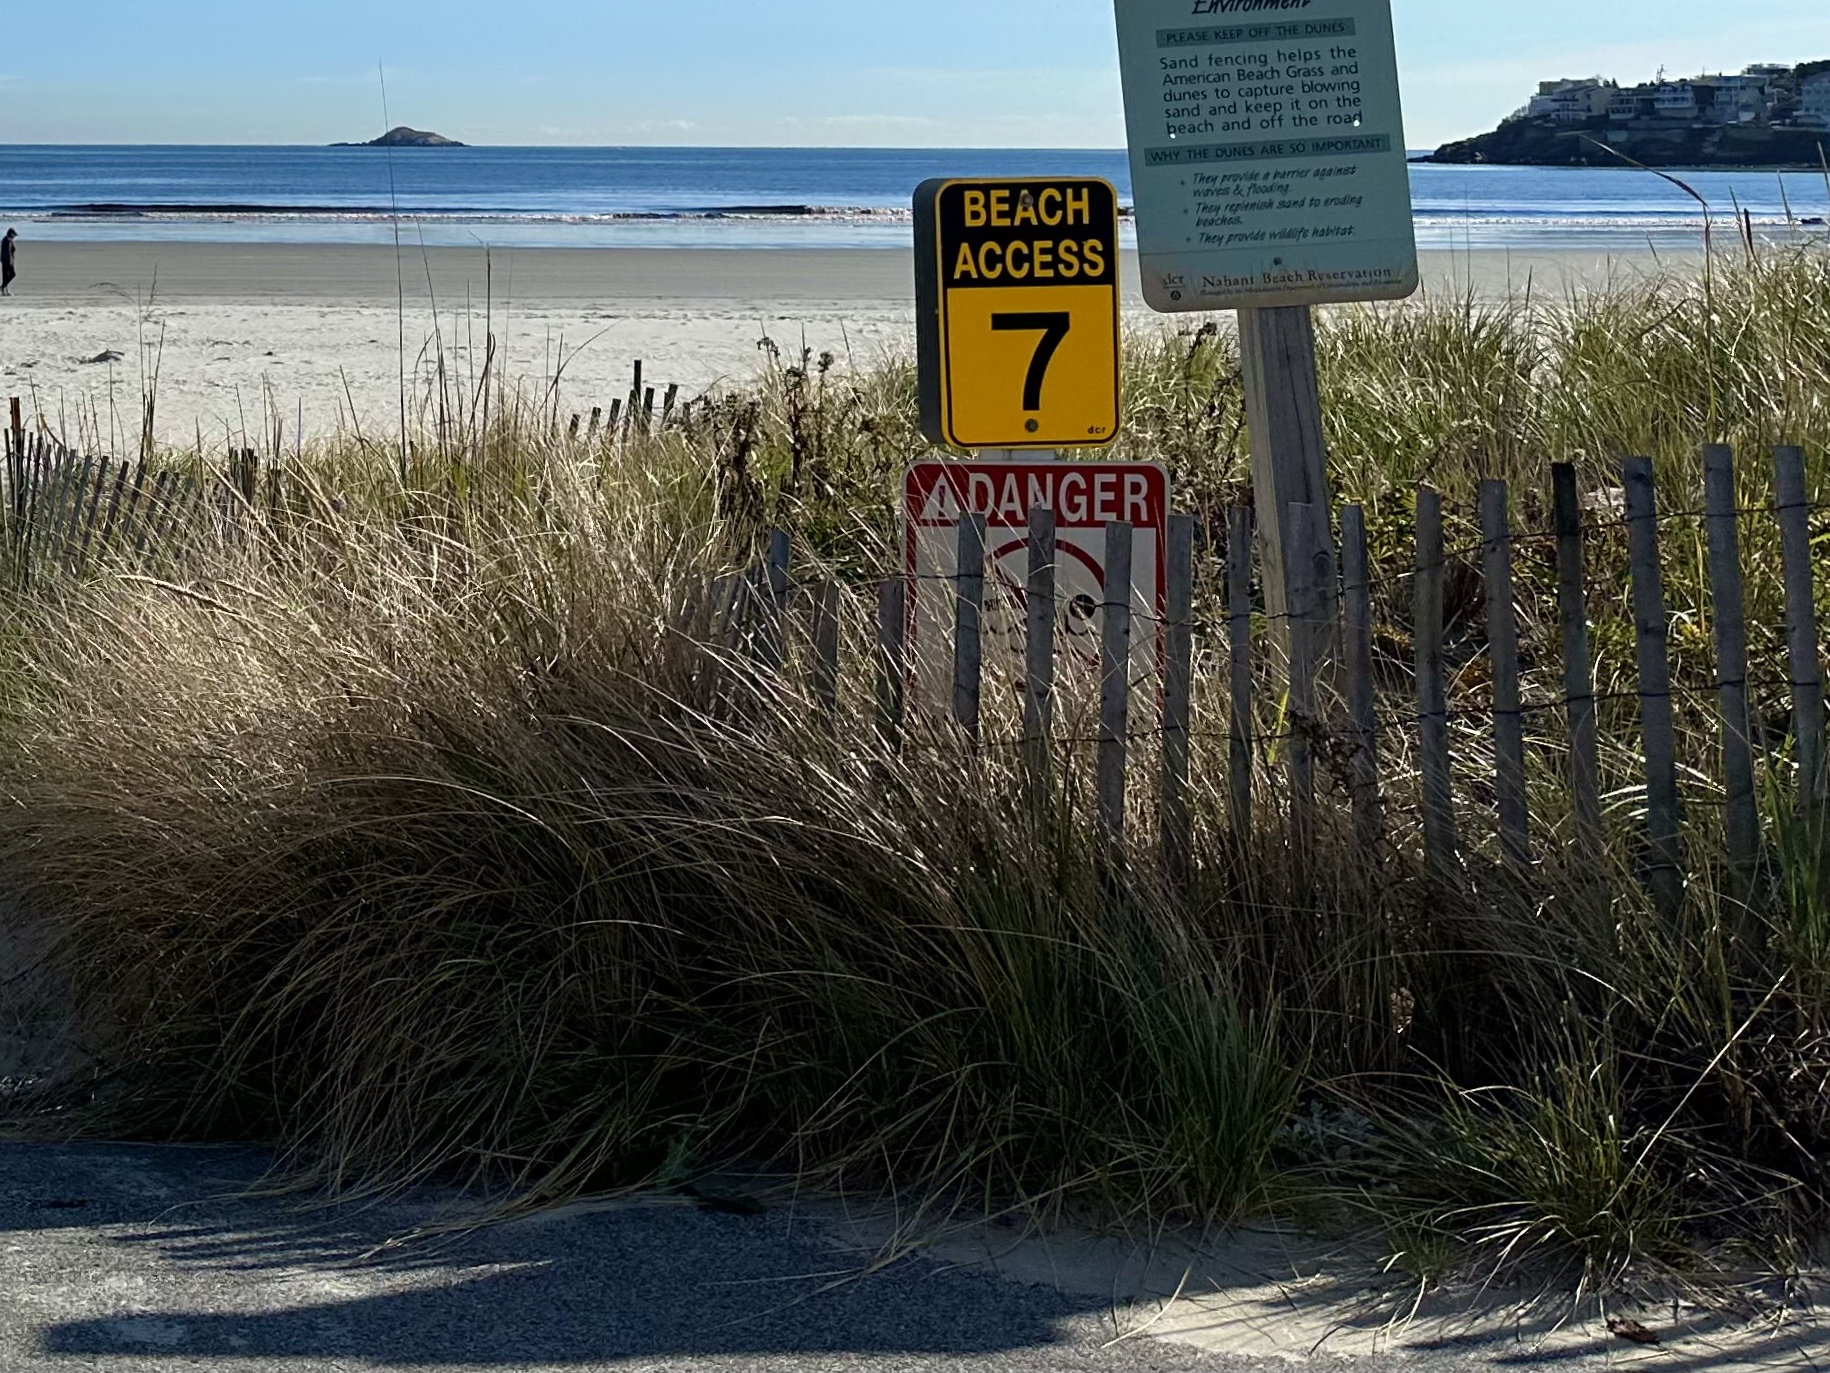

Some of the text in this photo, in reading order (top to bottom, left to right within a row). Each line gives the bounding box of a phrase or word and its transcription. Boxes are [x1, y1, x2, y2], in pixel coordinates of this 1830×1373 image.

[1166, 22, 1346, 44] PLEASE KEEP OFF THE DUNES
[1159, 45, 1357, 70] Sand fencing helps the
[1162, 61, 1359, 86] American Beach Grass and
[1163, 79, 1360, 103] dunes to capture blowing
[1164, 94, 1362, 118] sand and keep it on the
[1166, 119, 1214, 135] beach
[1221, 117, 1251, 132] and
[1259, 114, 1285, 129] off
[1291, 113, 1319, 127] the
[1150, 150, 1180, 162] WHY
[1187, 148, 1209, 160] THE
[1215, 146, 1255, 158] DUNES
[1260, 143, 1284, 156] ARE
[1289, 142, 1306, 154] SO
[1193, 172, 1218, 186] They
[1221, 170, 1260, 185] provide
[1273, 168, 1312, 180] barrier
[1312, 165, 1358, 181] against
[1192, 186, 1230, 198] waves
[1232, 184, 1245, 197] &
[963, 187, 1090, 228] BEACH
[1195, 194, 1363, 216] They replenish sand to eroding
[1198, 231, 1224, 246] They
[1225, 229, 1266, 246] provide
[1269, 226, 1309, 242] wildlife
[953, 238, 1106, 280] ACCESS
[1202, 274, 1255, 288] Nahant
[1262, 268, 1304, 285] Beach
[1307, 266, 1392, 283] Reservation
[990, 310, 1071, 411] 7
[1086, 424, 1107, 435] dcr
[969, 471, 1150, 523] DANGER
